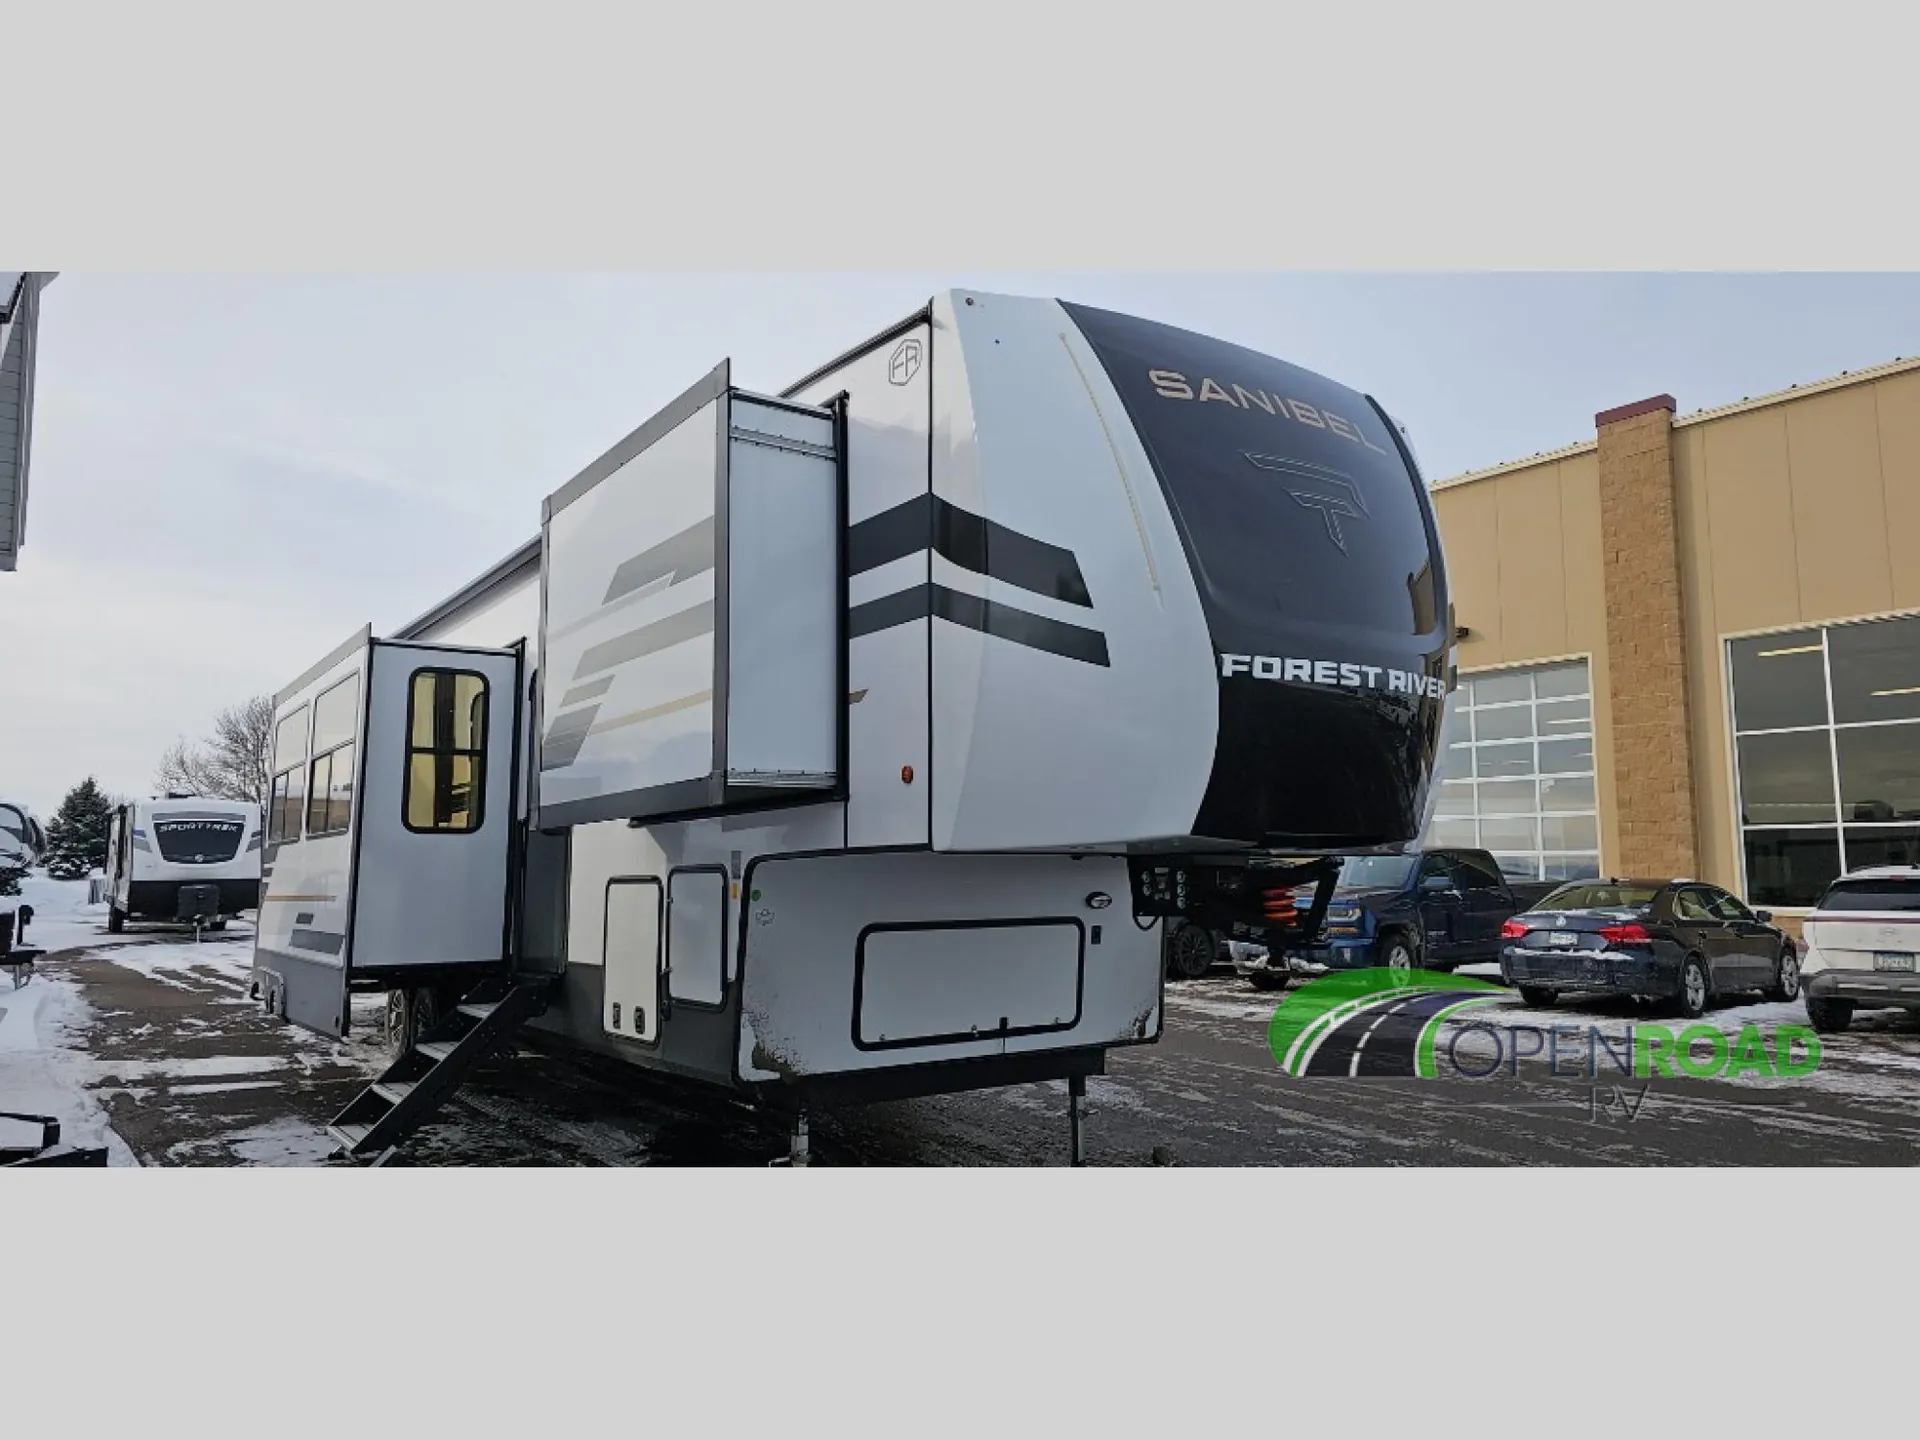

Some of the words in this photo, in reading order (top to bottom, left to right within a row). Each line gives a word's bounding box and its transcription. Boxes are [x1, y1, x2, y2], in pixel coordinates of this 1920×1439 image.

[1149, 369, 1387, 455] SANIBEL
[1220, 653, 1382, 688] FOREST
[1388, 668, 1446, 699] RIVER
